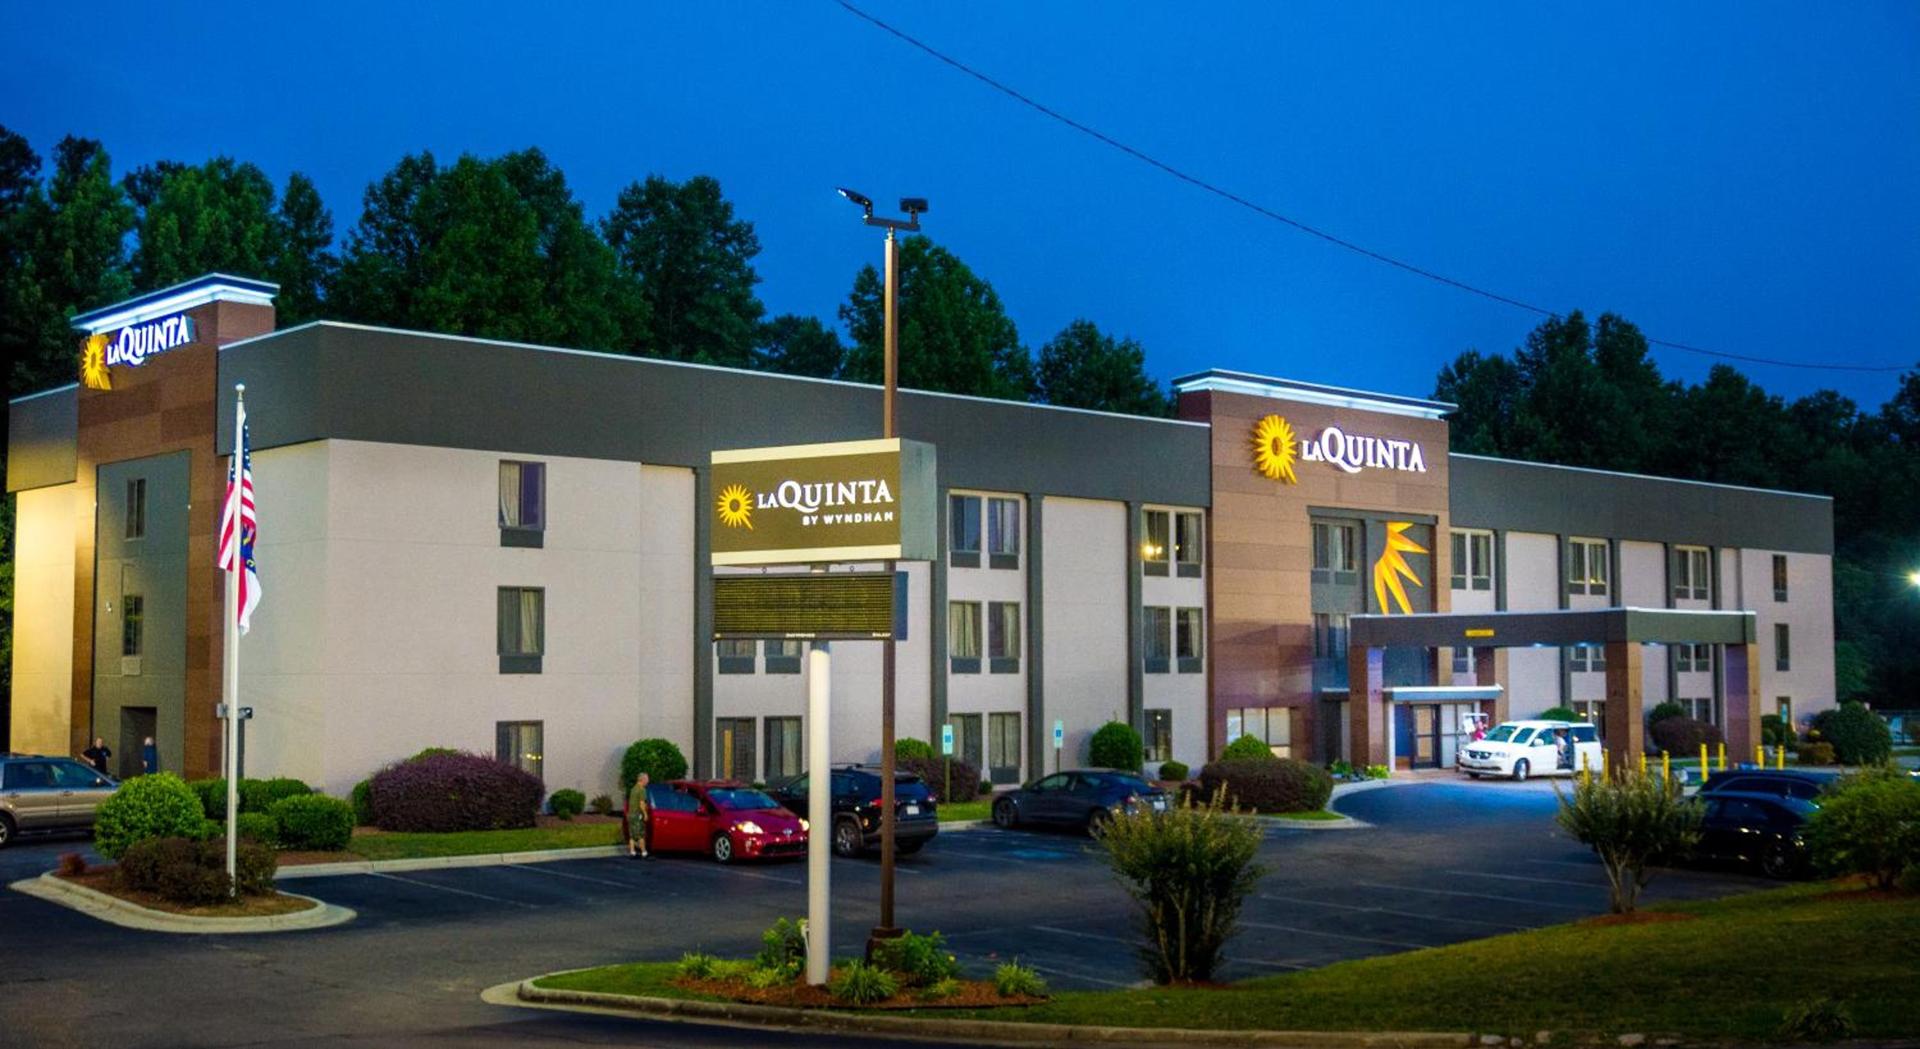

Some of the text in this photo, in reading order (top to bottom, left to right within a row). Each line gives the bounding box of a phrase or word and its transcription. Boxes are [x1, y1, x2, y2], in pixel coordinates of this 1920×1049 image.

[1321, 427, 1427, 473] QUINTA
[778, 479, 894, 513] QUINTA
[802, 512, 894, 526] BY WYNDHAM
